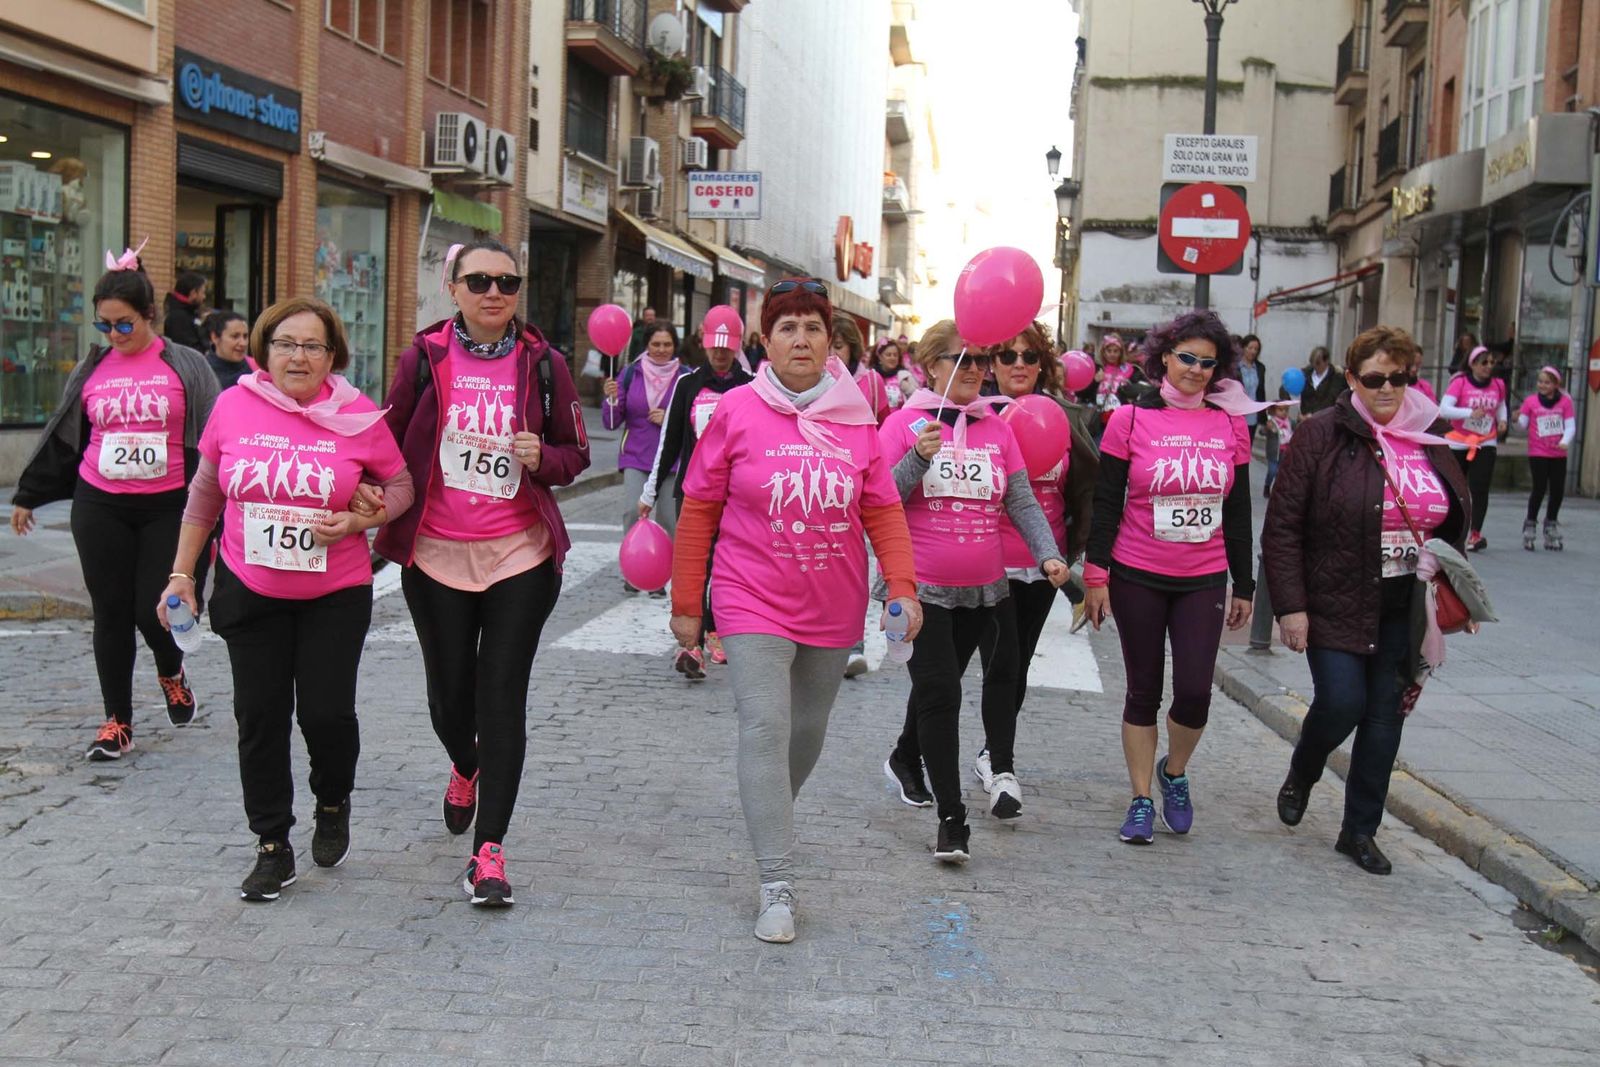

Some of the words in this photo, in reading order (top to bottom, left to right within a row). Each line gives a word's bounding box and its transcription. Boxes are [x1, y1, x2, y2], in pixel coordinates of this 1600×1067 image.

[257, 93, 299, 134] store
[1175, 137, 1210, 148] EXCEPTO
[1211, 138, 1246, 149] GARAJES
[1173, 150, 1193, 161] SOLO
[1195, 151, 1210, 161] CON
[1212, 152, 1232, 162] GRAN
[1236, 153, 1248, 162] VIA
[1171, 163, 1205, 174] CORTADA
[1206, 165, 1216, 175] AL
[1218, 166, 1249, 176] TRAFICO
[691, 174, 758, 182] ALMACENES
[695, 185, 754, 197] CASERO
[457, 375, 490, 384] CARRERA
[465, 383, 490, 391] MUJER
[255, 433, 290, 443] CARRERA
[459, 433, 488, 444] CARRERA
[465, 439, 487, 449] MUJER
[261, 440, 289, 450] MUJER
[297, 444, 336, 454] RUNNING
[1198, 441, 1225, 450] RUNNING
[114, 447, 156, 465] 240
[459, 449, 511, 479] 156
[261, 507, 290, 516] CARRERA
[1171, 507, 1213, 528] 528
[267, 514, 290, 522] MUJER
[263, 524, 315, 551] 150
